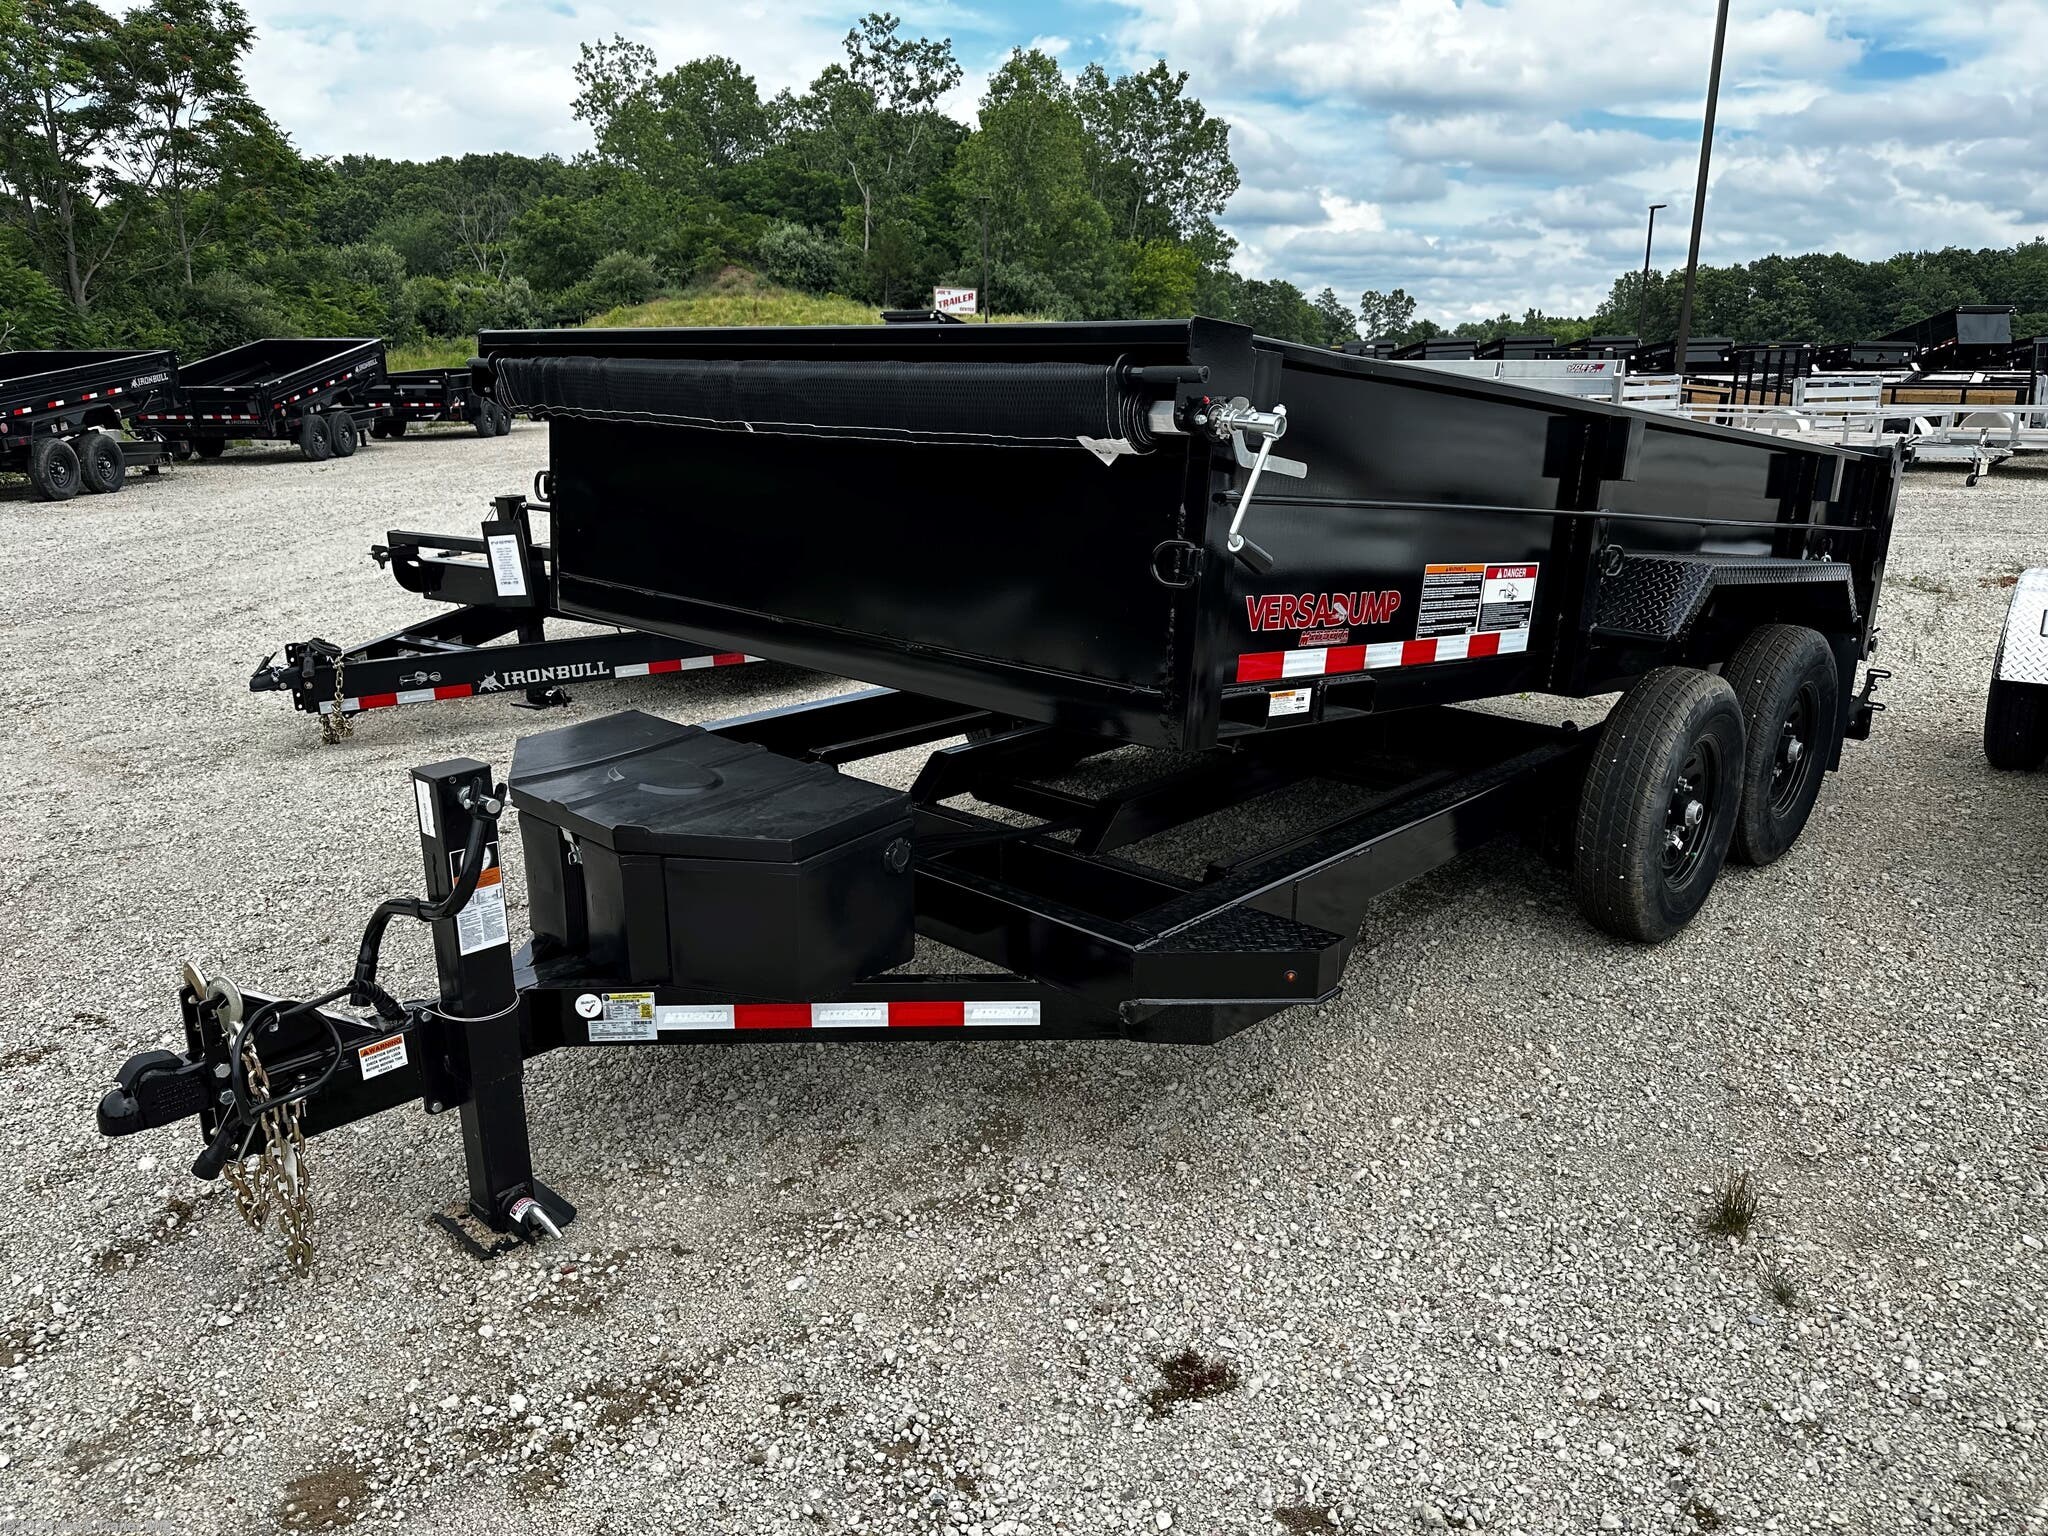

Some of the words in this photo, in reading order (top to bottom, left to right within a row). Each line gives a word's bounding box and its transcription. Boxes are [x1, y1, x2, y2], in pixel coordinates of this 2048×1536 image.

[938, 292, 974, 309] TRAILER
[138, 372, 169, 386] IRONBULL
[1503, 568, 1526, 578] DANGER
[1246, 590, 1402, 631] VERSADUMP
[502, 661, 610, 686] IRONBULL
[368, 1037, 402, 1053] WARNING
